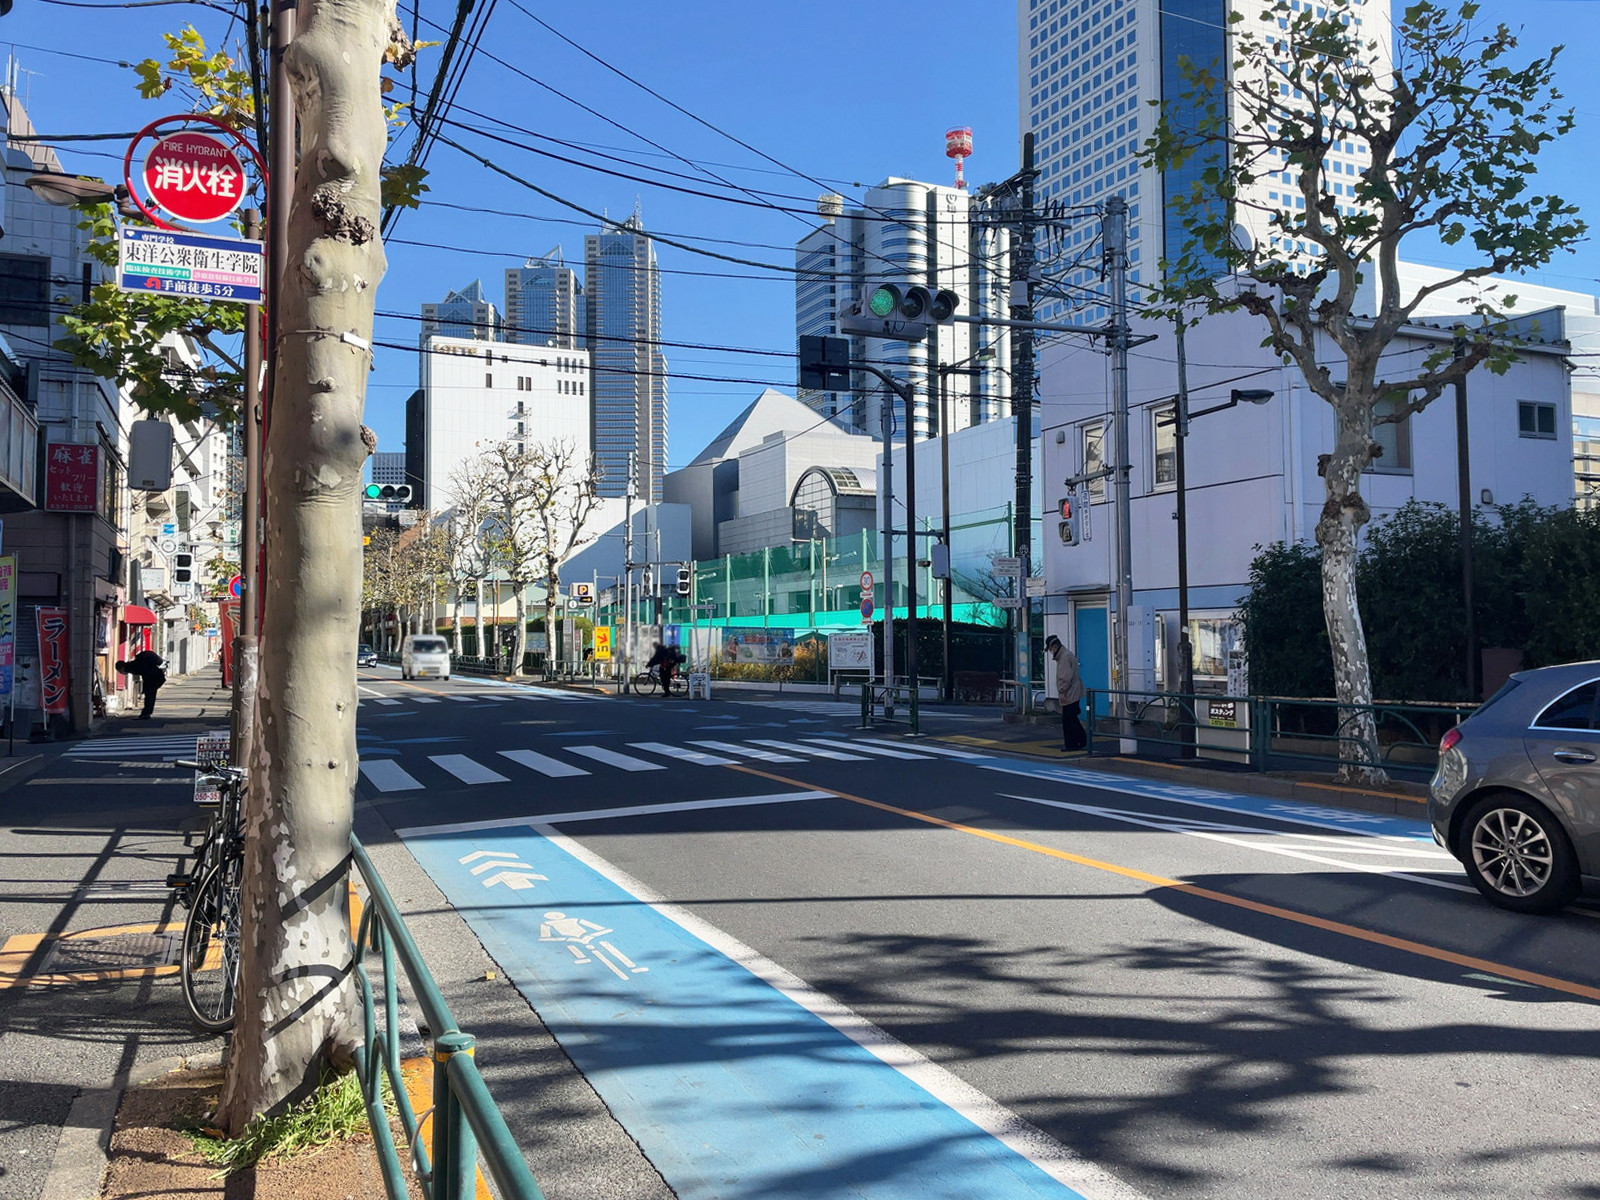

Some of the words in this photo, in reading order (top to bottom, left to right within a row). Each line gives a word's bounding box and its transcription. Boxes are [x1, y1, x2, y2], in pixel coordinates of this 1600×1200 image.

[162, 141, 183, 153] FIRE
[186, 144, 228, 158] HYDRANT
[155, 156, 237, 197] 消火栓
[141, 233, 175, 244] 専門学校
[126, 242, 258, 274] 東洋公衆衛生学院
[162, 280, 234, 297] 手前徒歩5分
[53, 446, 95, 465] 麻雀
[49, 465, 71, 475] セット
[579, 585, 587, 595] P
[42, 617, 66, 706] ラーメン
